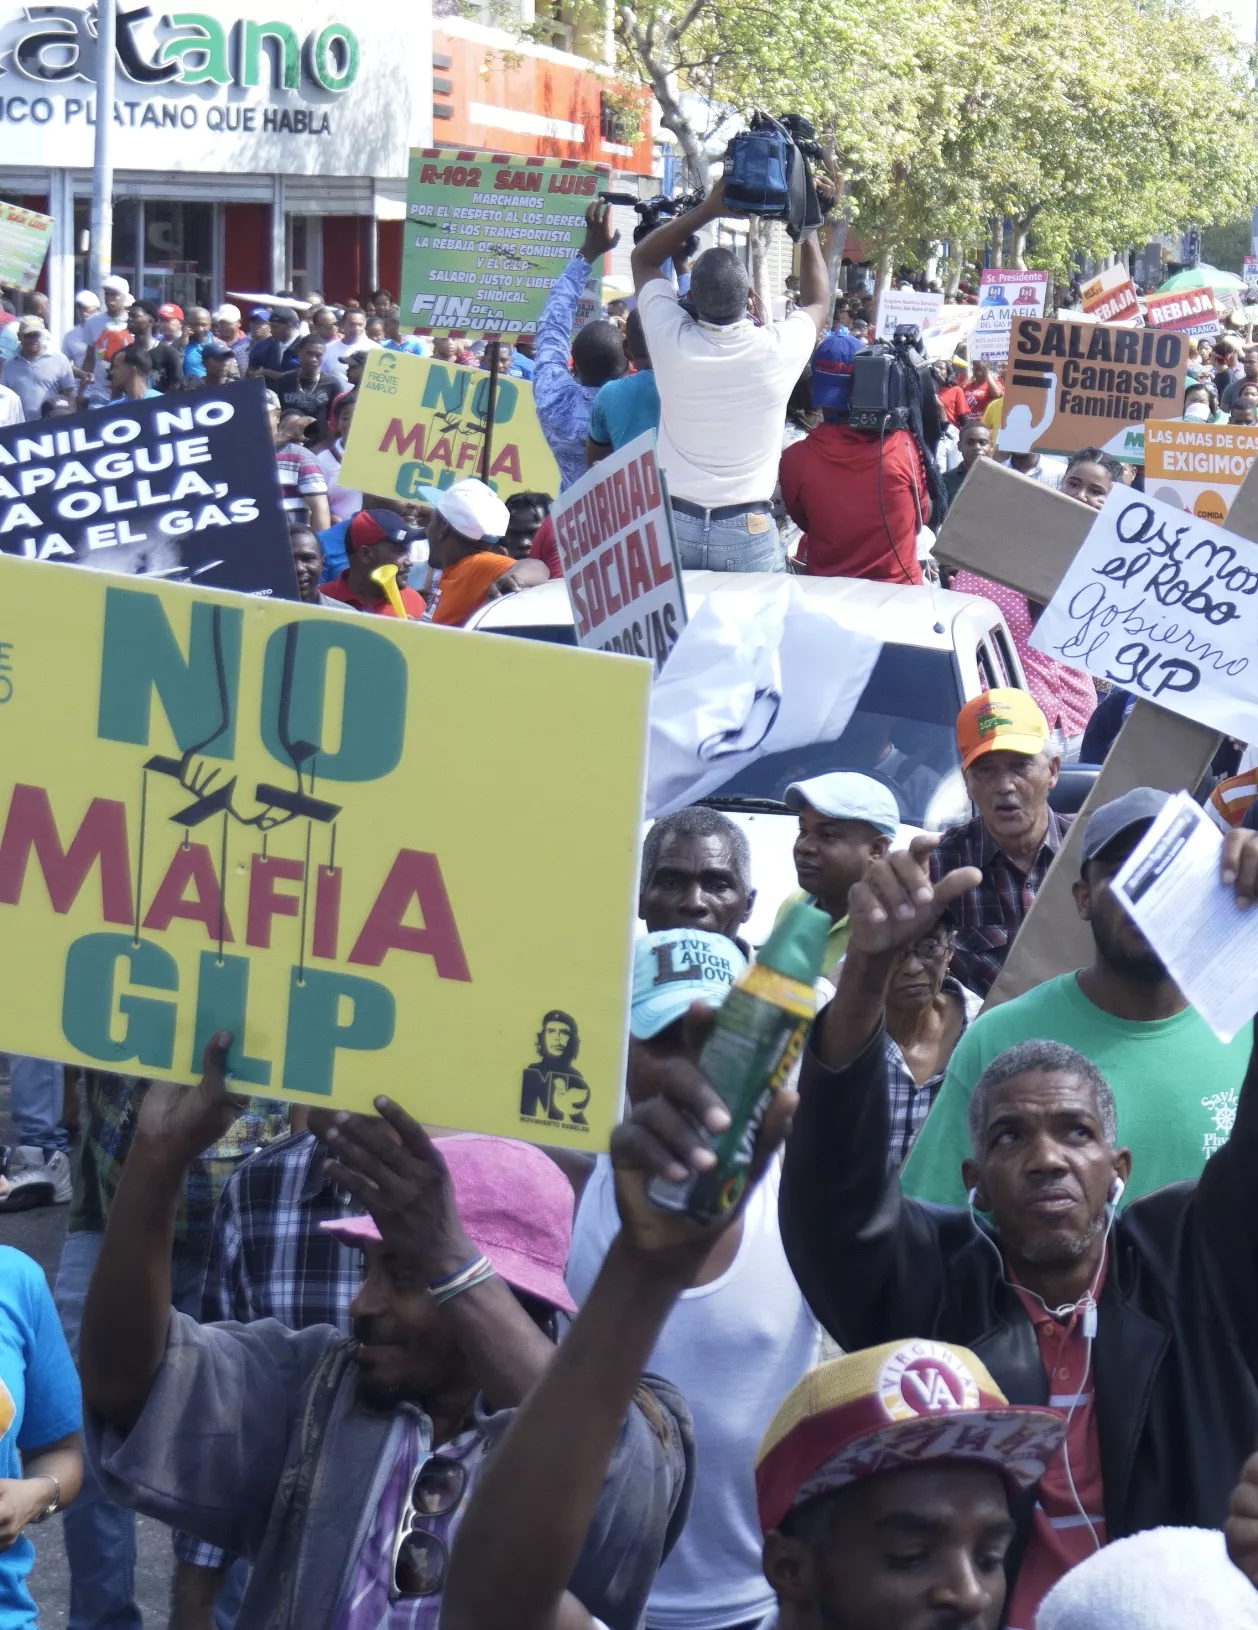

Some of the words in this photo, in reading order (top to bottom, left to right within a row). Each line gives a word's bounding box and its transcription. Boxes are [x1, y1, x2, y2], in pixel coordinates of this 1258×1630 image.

[207, 105, 256, 133] QUE
[263, 107, 331, 136] HABLA
[420, 163, 482, 188] R-102
[494, 169, 544, 192] SAN
[548, 173, 599, 197] LUIS
[411, 204, 433, 217] POR
[436, 206, 449, 218] EL
[453, 207, 503, 222] RESPETO
[505, 209, 519, 223] AL
[522, 211, 544, 225] LOS
[472, 191, 545, 209] MARCHAMOS
[415, 236, 429, 249] LA
[432, 238, 475, 252] REBAJA
[460, 224, 482, 236] LOS
[483, 225, 571, 242] TRANSPORTISTA
[428, 269, 477, 285] SALARIO
[479, 272, 513, 287] JUSTO
[515, 275, 524, 287] Y
[476, 257, 484, 268] Y
[486, 257, 500, 270] EL
[987, 274, 996, 283] Sr.
[999, 272, 1043, 282] Presidente
[411, 293, 474, 317] FIN
[981, 309, 995, 321] LA
[999, 307, 1037, 320] MAFIA
[1095, 288, 1135, 320] EBAJA
[1151, 294, 1213, 325] REBAJA
[1017, 320, 1182, 369] SALARIO
[365, 381, 398, 396] AMPLIO
[368, 372, 400, 387] FRENTE
[420, 364, 519, 425] NO
[1062, 359, 1177, 399] Canasta
[156, 401, 235, 435] NO
[1059, 390, 1154, 421] Familiar
[379, 417, 523, 484] MAFIA
[1148, 429, 1173, 444] LAS
[1175, 431, 1213, 447] AMAS
[1216, 434, 1234, 448] DE
[58, 471, 229, 519] OLLA,
[556, 449, 661, 571] SEGURIDAD
[87, 520, 148, 550] EL
[159, 498, 261, 535] GAS
[1197, 510, 1224, 520] COMIDA
[570, 519, 674, 640] SOCIAL
[1092, 553, 1151, 588] el
[1144, 562, 1242, 626] Robo
[1053, 632, 1110, 668] el
[97, 586, 408, 783] NO
[0, 782, 472, 982] MAFIA
[61, 931, 396, 1096] GLP
[882, 1342, 974, 1389] VIRGINIA
[902, 1368, 961, 1410] VA
